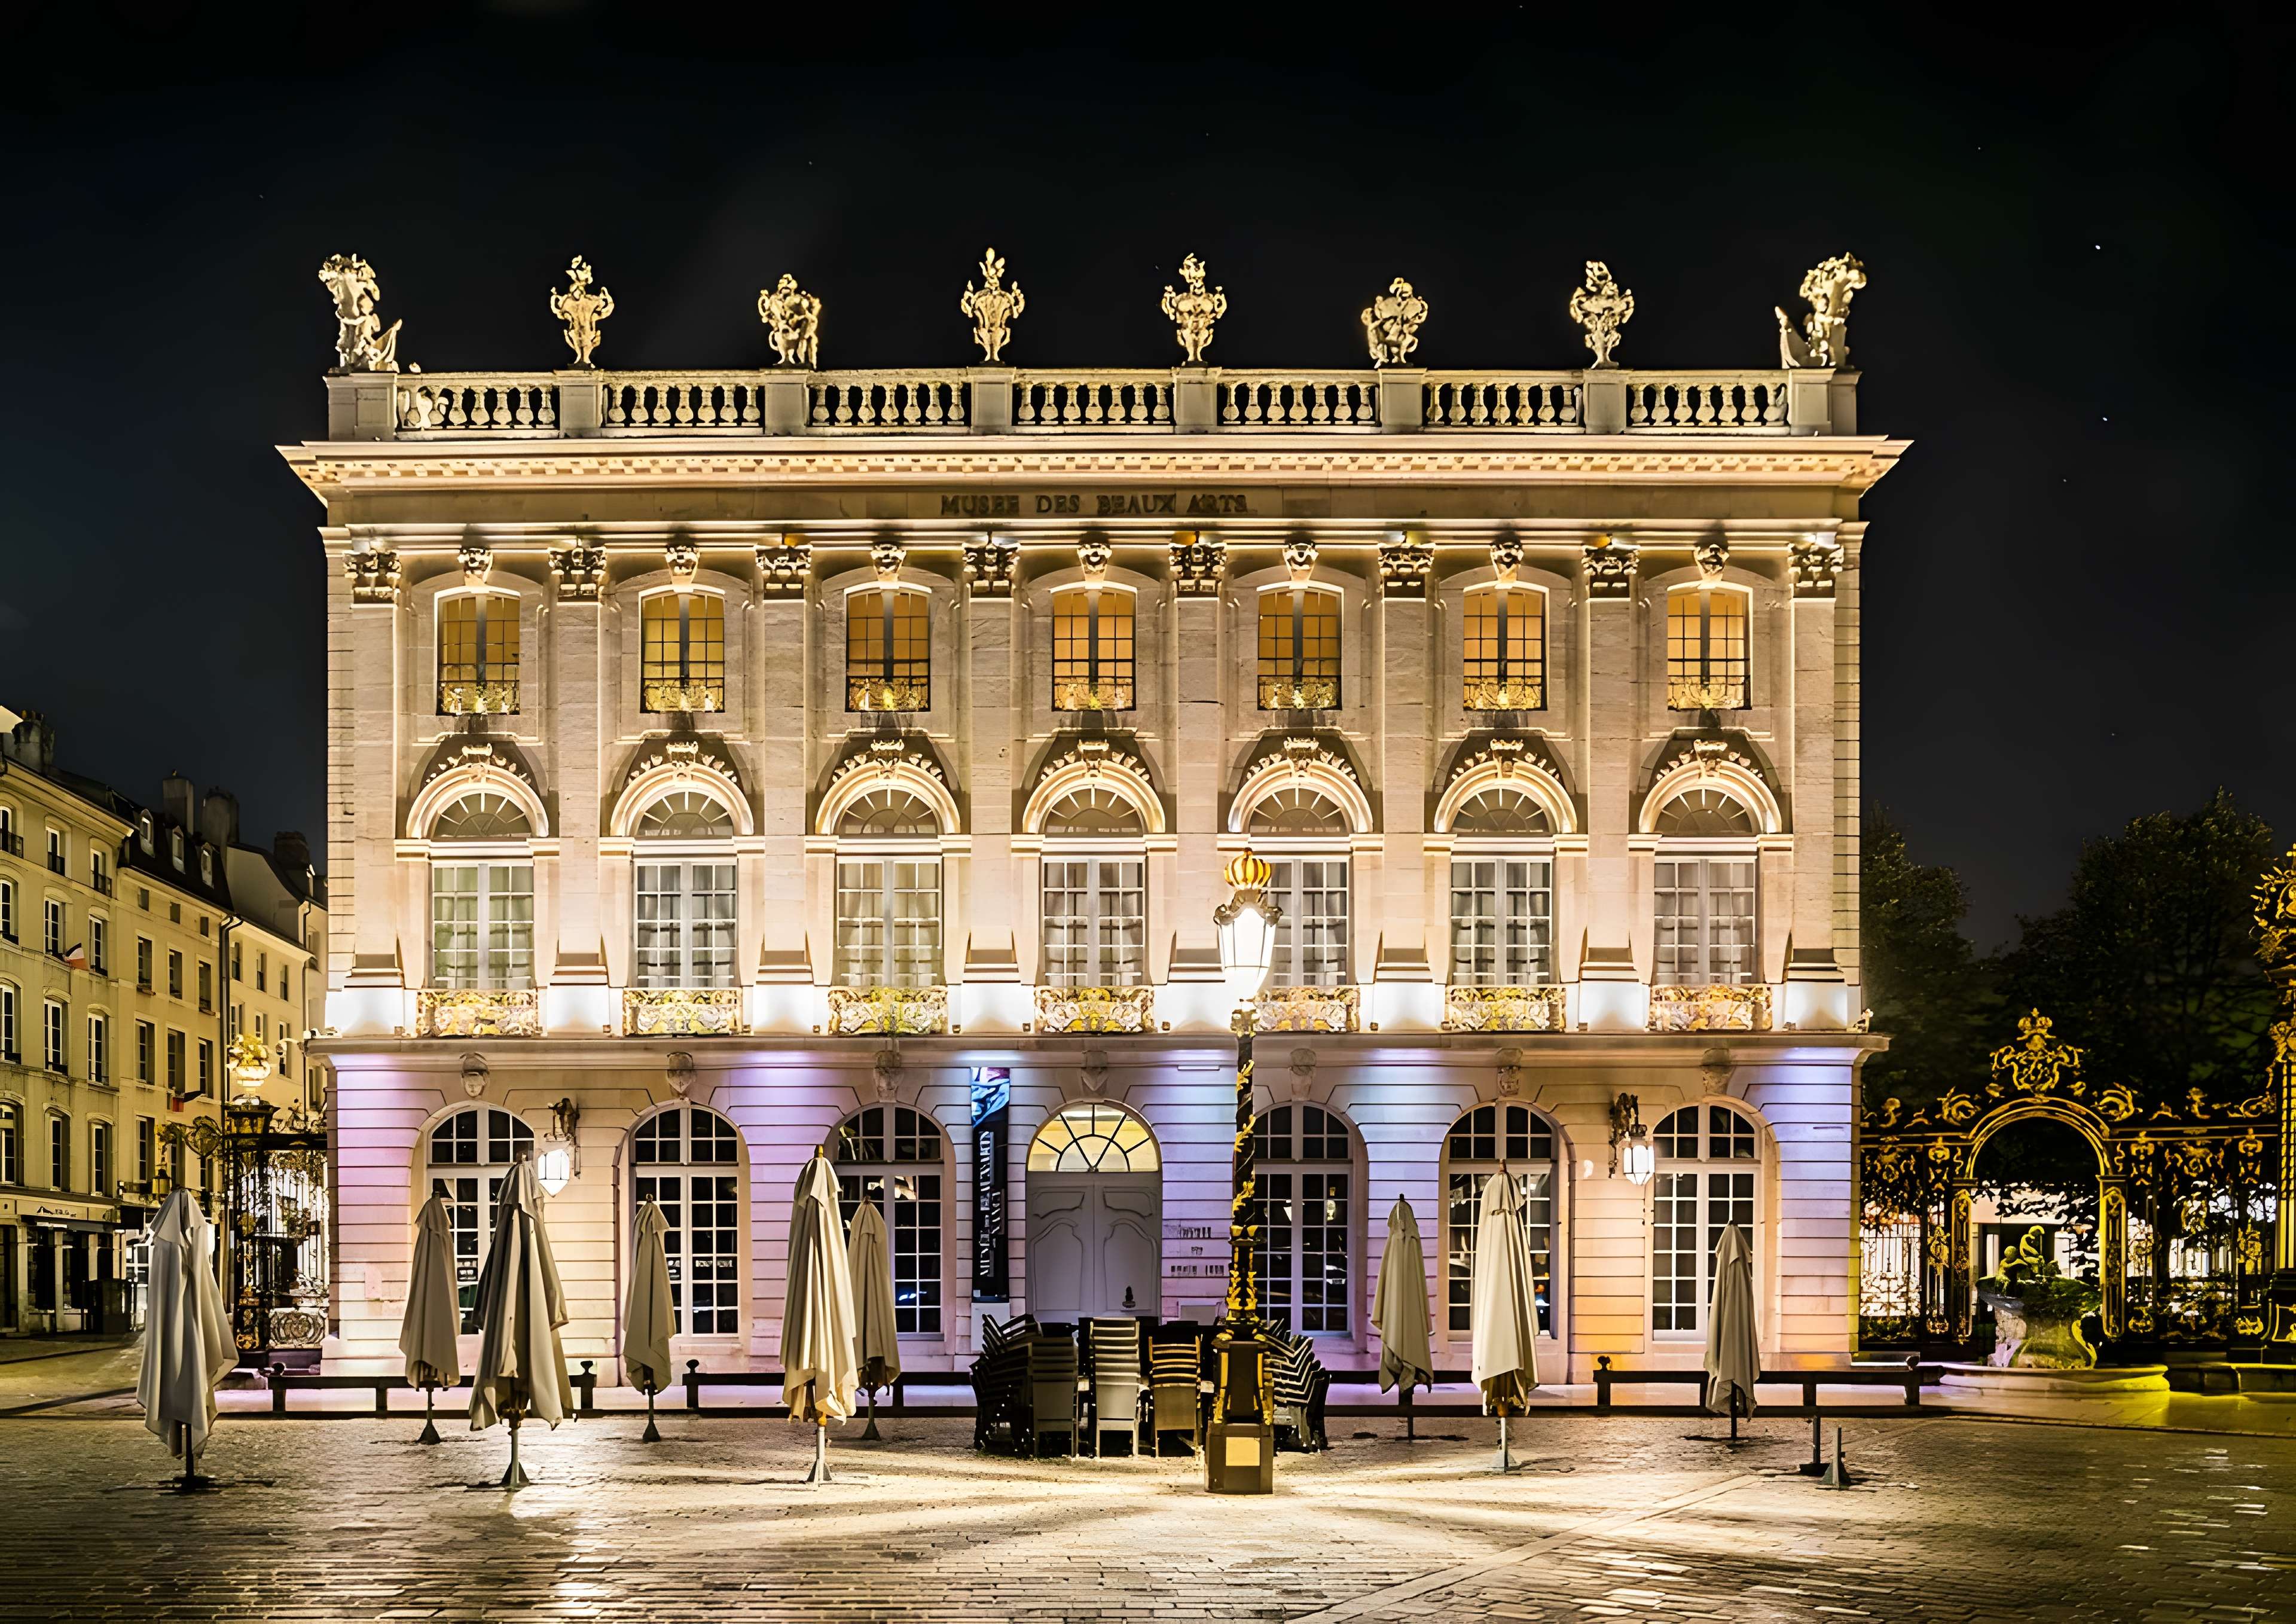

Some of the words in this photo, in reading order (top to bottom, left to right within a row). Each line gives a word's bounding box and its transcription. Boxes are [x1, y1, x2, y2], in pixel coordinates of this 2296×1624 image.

[1036, 494, 1080, 513] DES
[1097, 494, 1177, 515] BEAUX
[1186, 494, 1248, 513] ARTS
